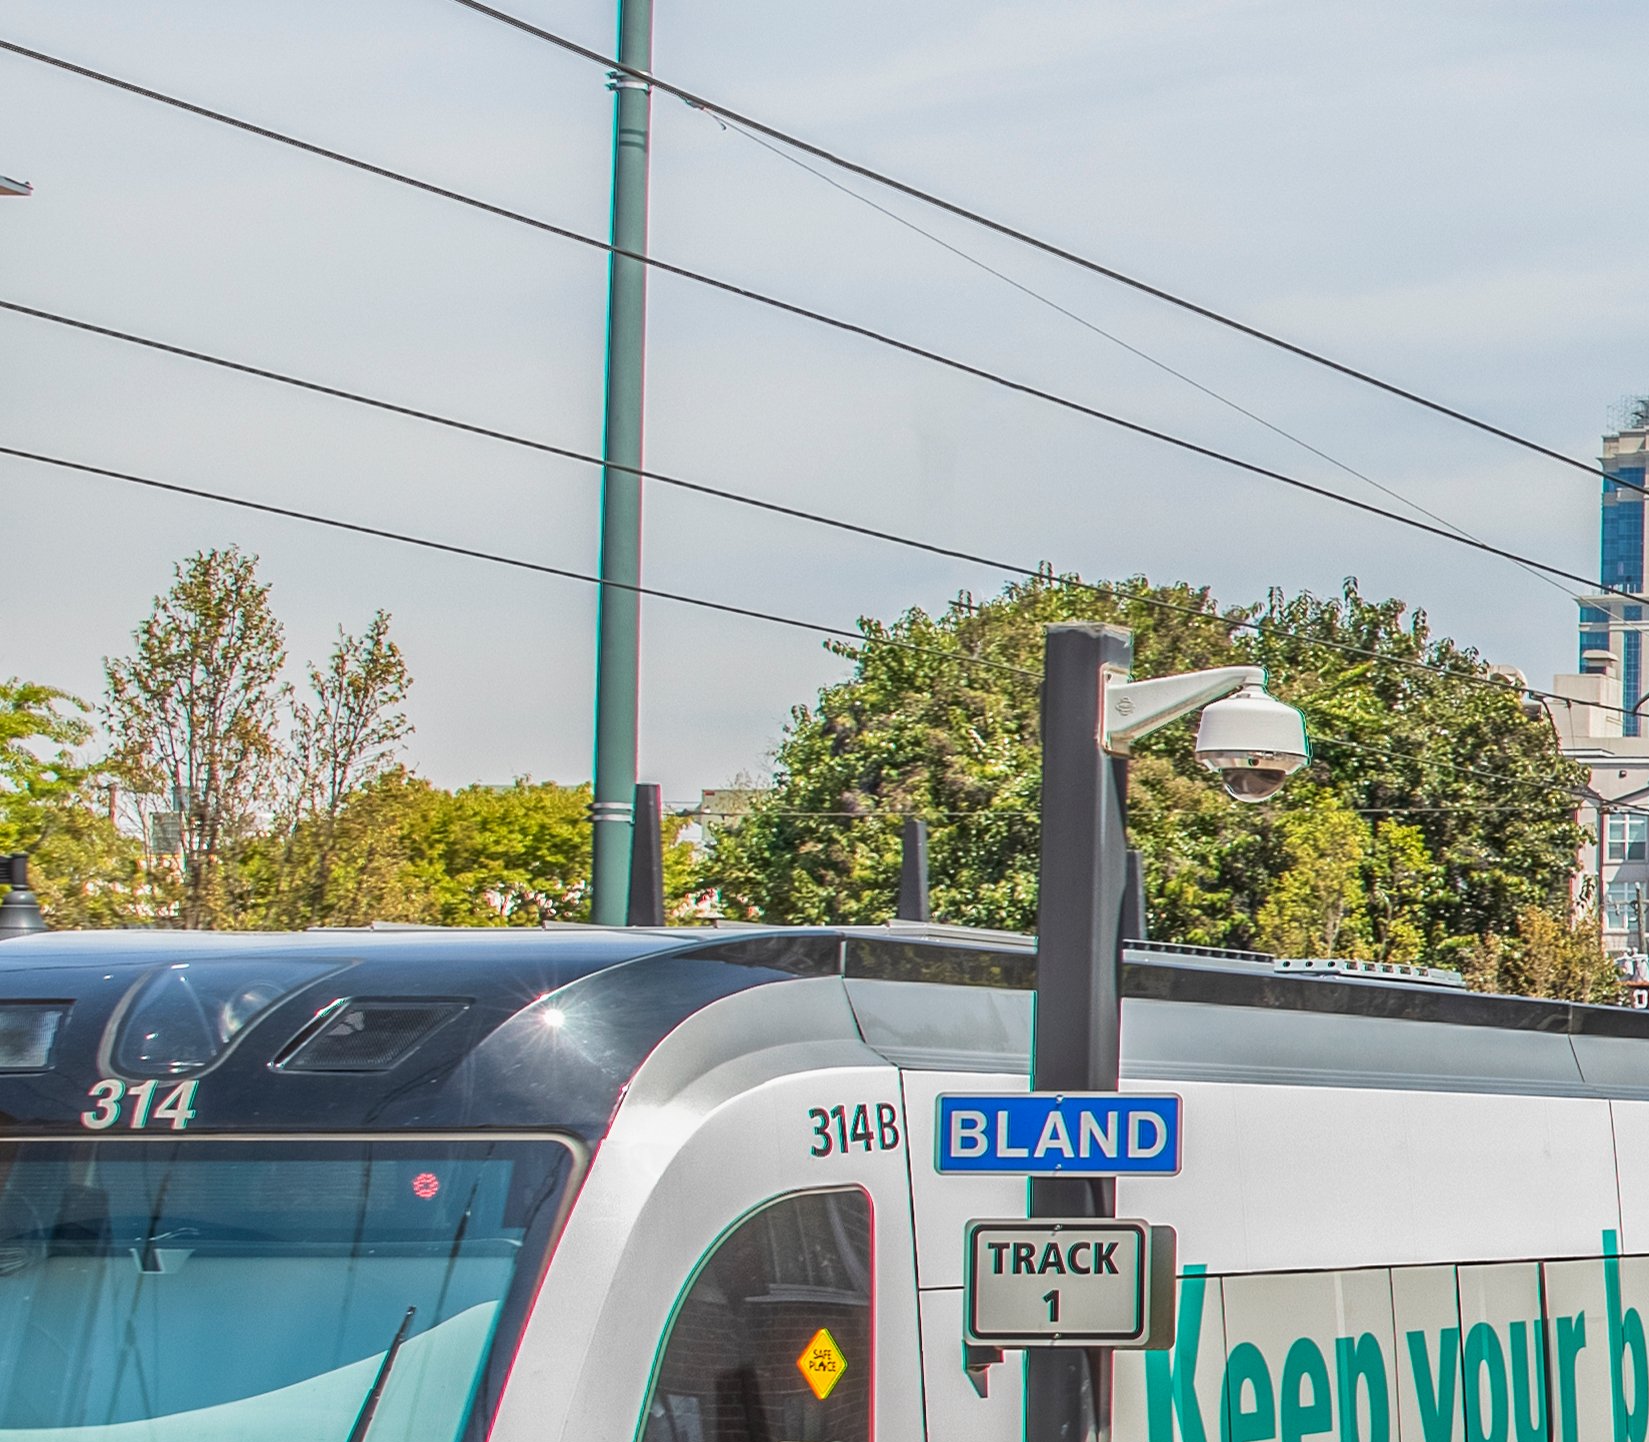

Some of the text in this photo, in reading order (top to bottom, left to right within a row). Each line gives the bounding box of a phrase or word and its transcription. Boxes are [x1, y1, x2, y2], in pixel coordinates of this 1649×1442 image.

[81, 1079, 197, 1131] 314
[808, 1102, 901, 1157] 314B
[949, 1110, 1168, 1158] BLAND
[987, 1241, 1119, 1276] TRACK
[1043, 1290, 1062, 1323] 1
